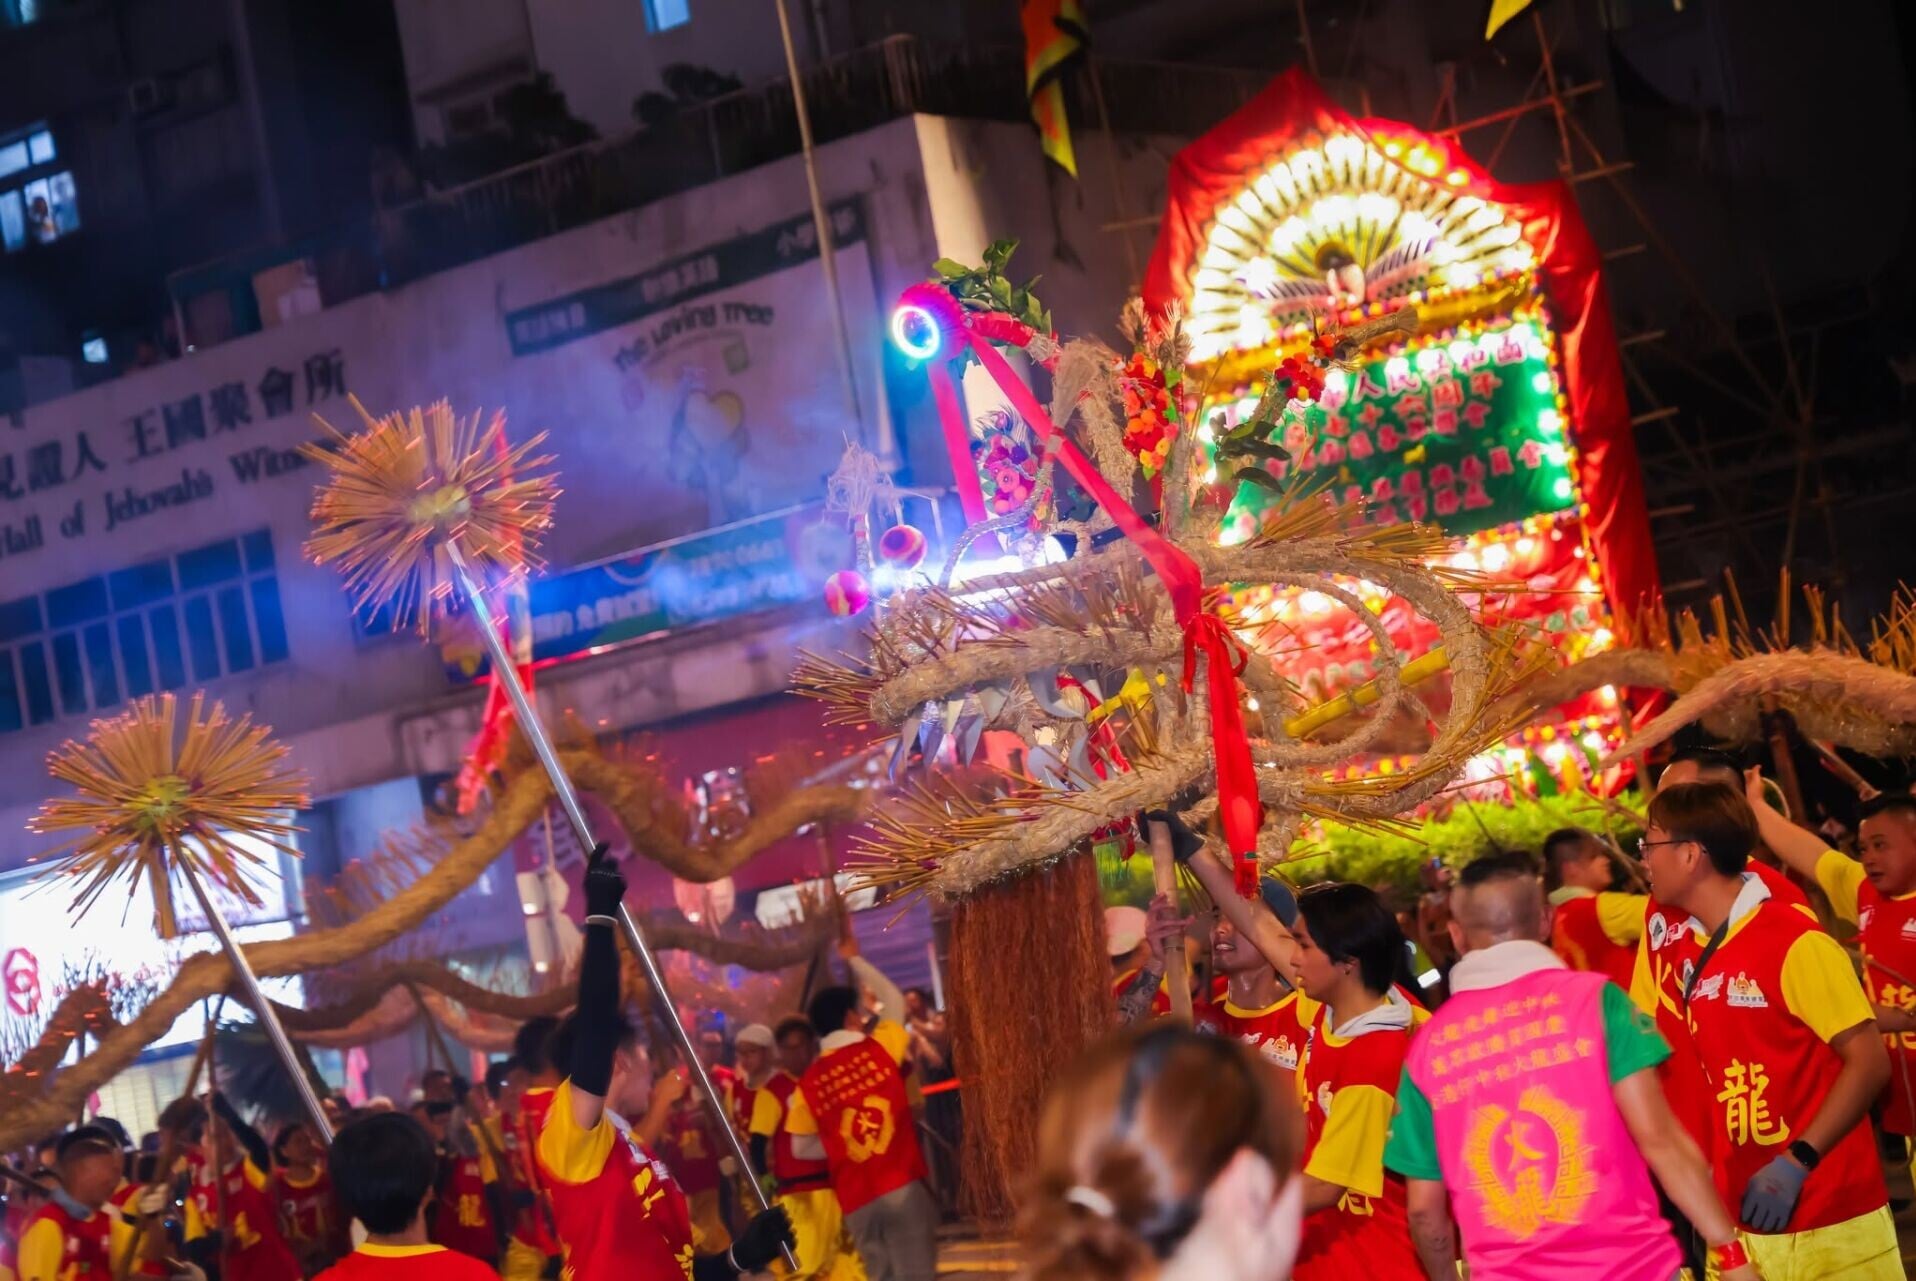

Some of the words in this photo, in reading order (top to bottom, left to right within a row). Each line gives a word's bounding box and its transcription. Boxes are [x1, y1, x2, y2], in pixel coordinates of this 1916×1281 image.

[722, 302, 775, 327] Tree
[60, 499, 86, 539] of
[1716, 1057, 1791, 1147] 龍
